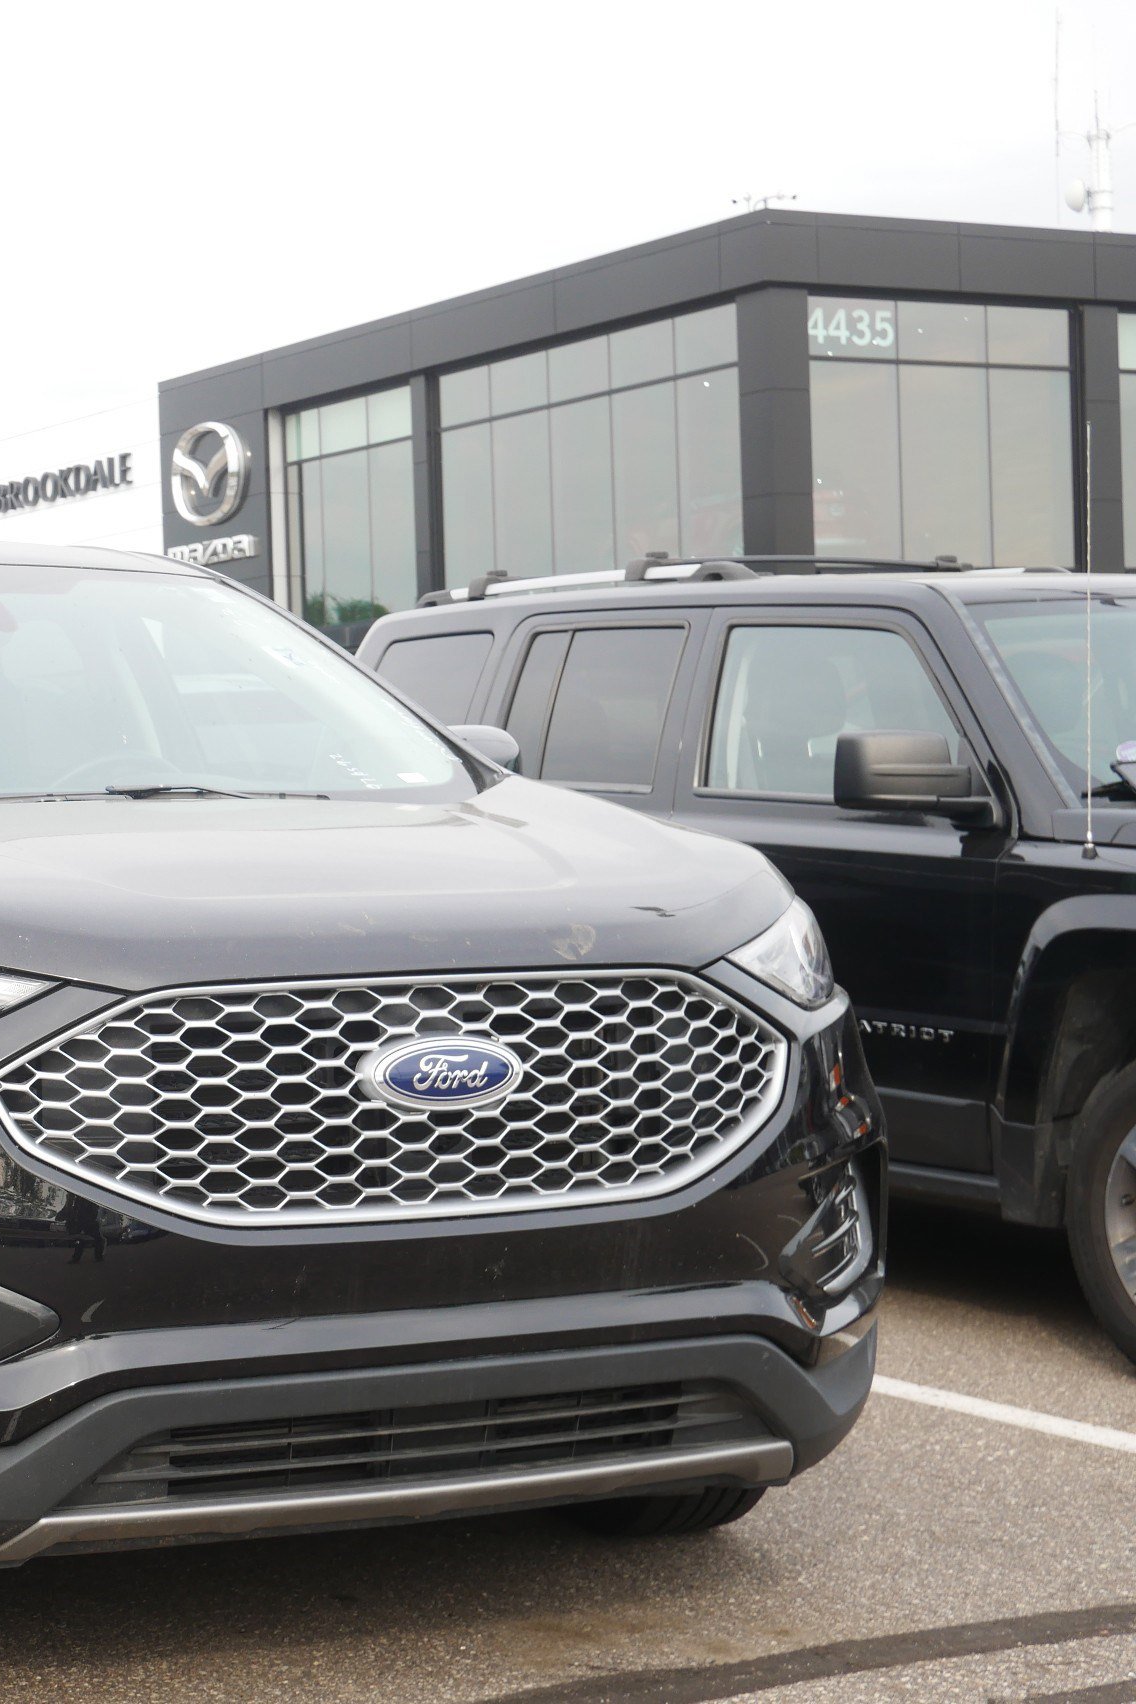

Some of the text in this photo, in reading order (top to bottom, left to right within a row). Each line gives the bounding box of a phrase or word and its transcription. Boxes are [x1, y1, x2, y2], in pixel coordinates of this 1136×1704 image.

[807, 306, 895, 348] 4435
[858, 1018, 955, 1043] ATRIOT
[412, 1053, 489, 1091] Ford
